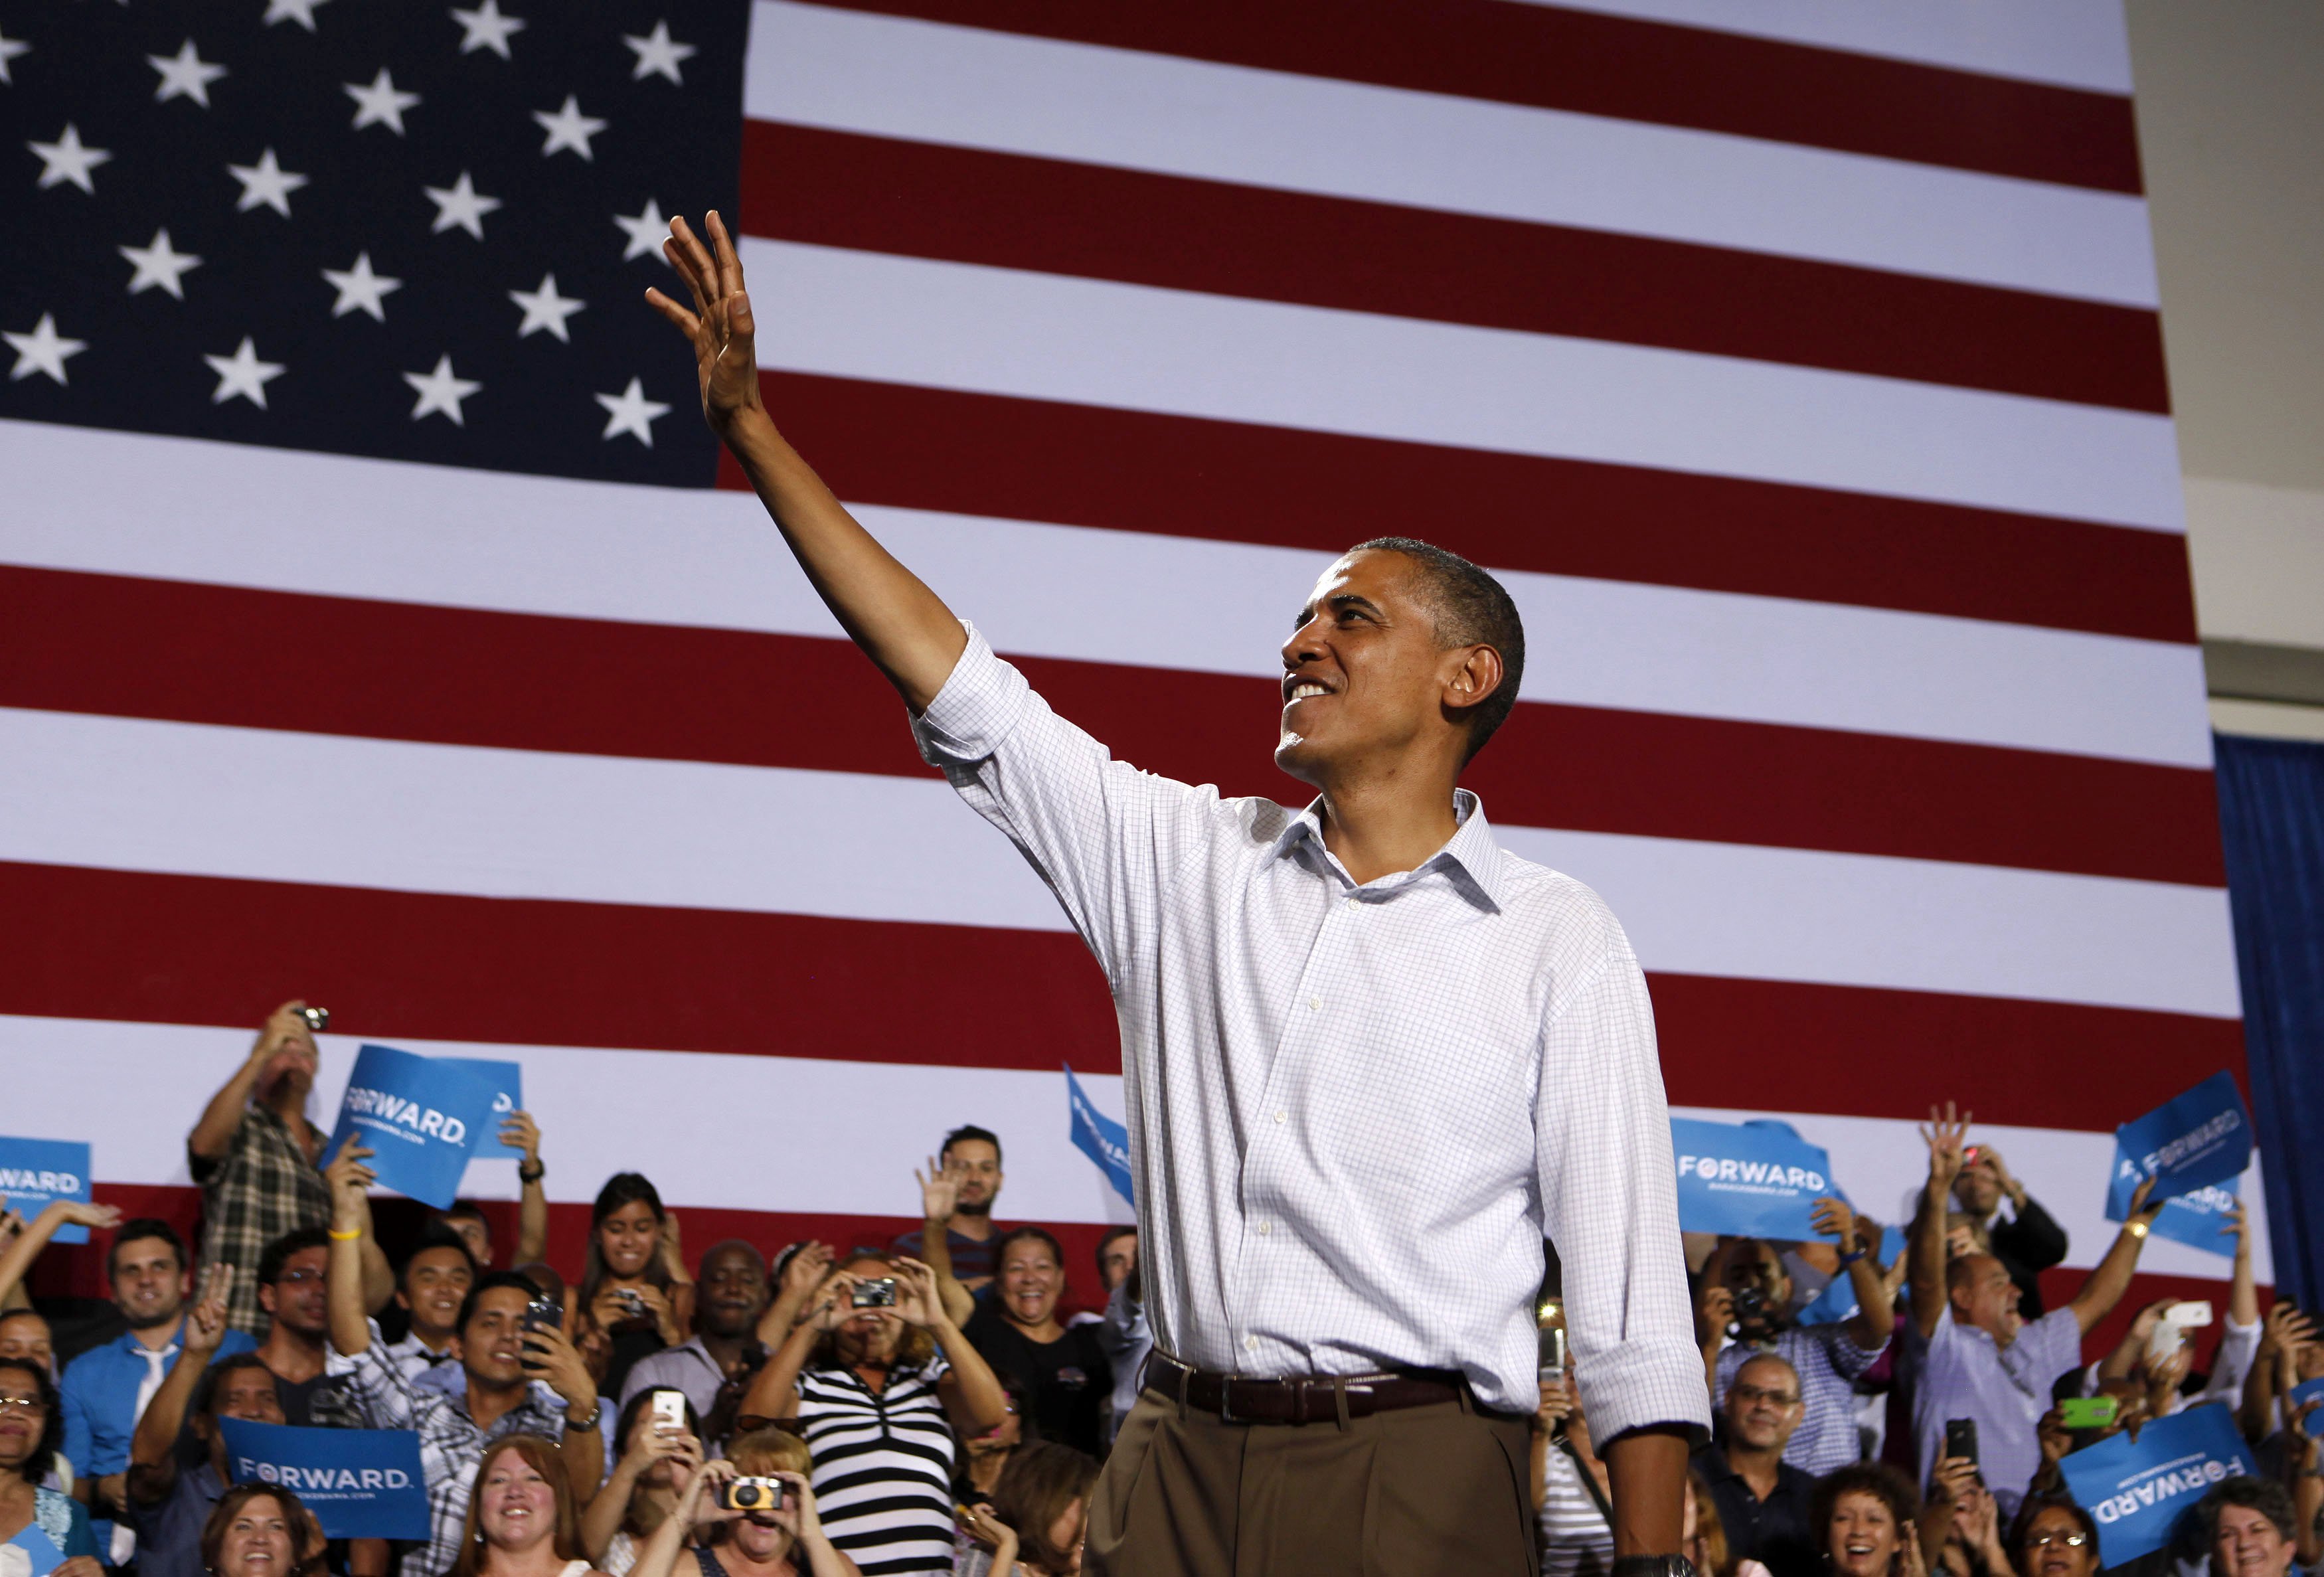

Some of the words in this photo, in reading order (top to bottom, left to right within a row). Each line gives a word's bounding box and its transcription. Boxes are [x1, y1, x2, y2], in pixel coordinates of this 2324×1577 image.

[1678, 1155, 1825, 1191] FORWARD
[237, 1456, 410, 1489] FORWARD
[2094, 1455, 2246, 1525] FORWARD
